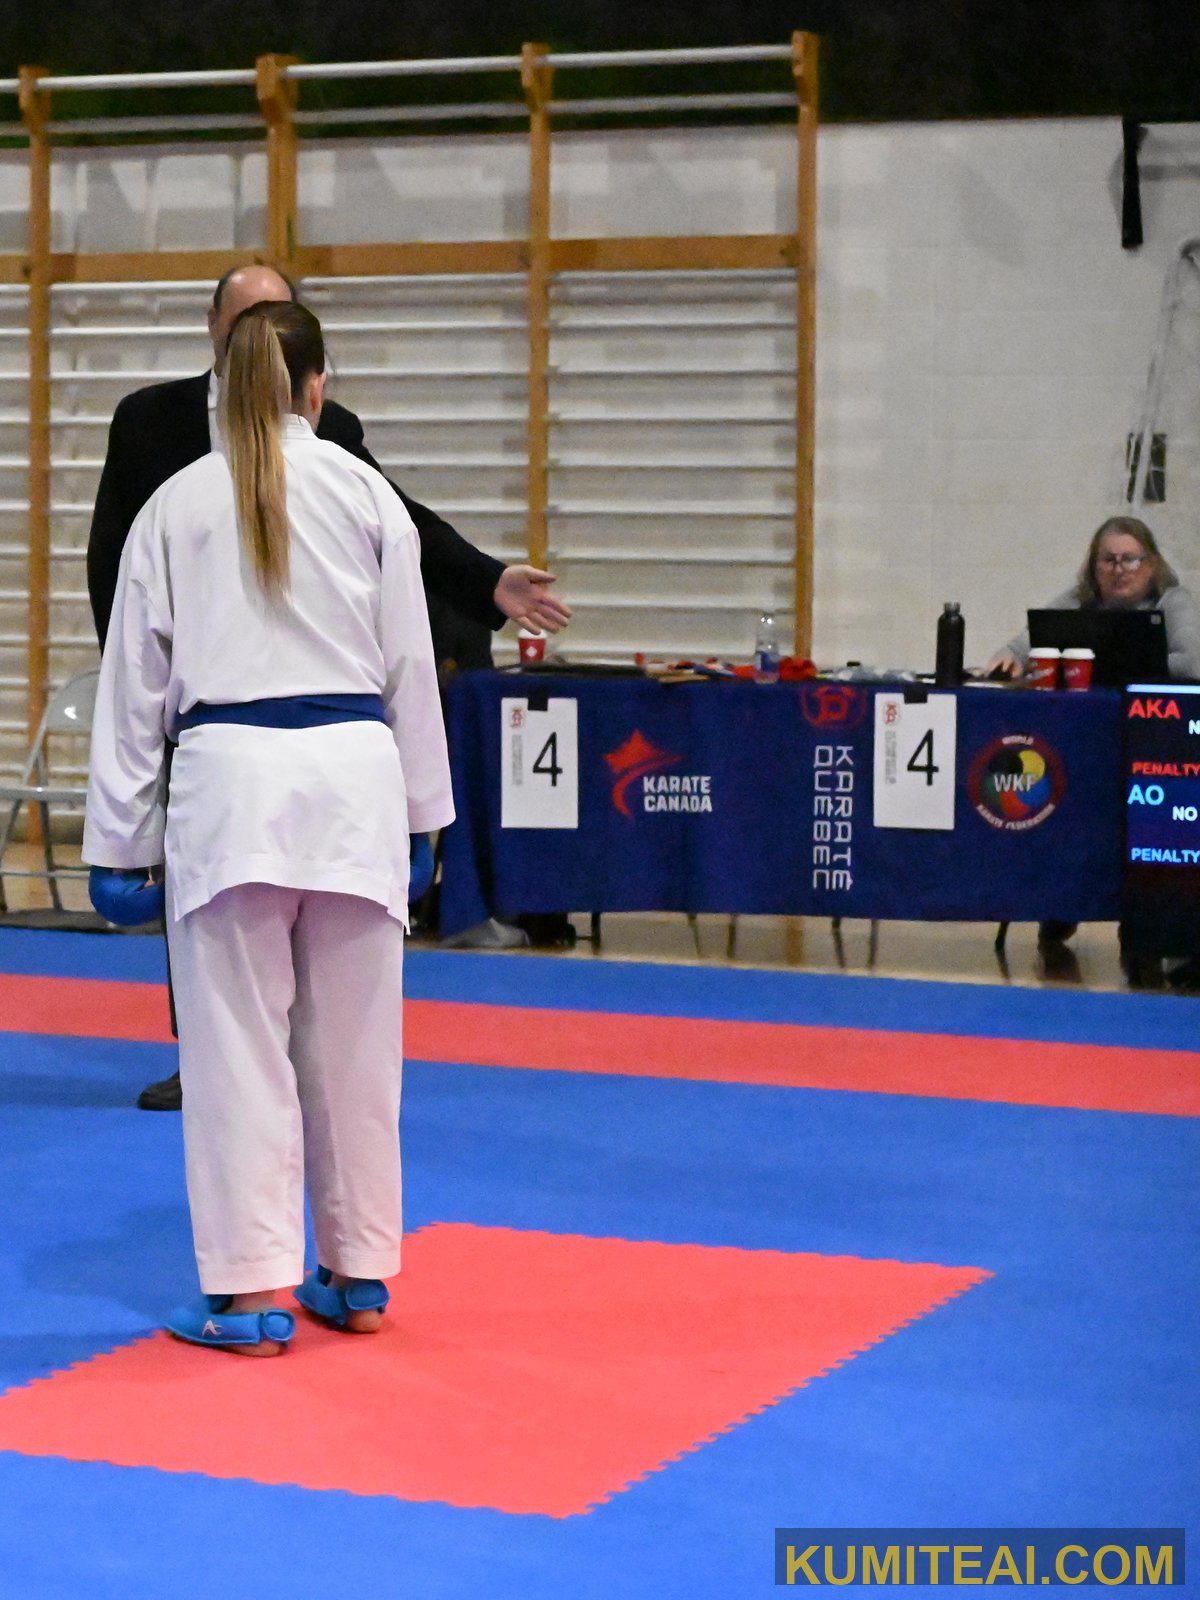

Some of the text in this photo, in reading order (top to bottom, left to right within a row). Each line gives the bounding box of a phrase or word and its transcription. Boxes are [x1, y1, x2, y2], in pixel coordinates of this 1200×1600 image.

[1128, 699, 1181, 720] AKA
[532, 731, 563, 787] 4
[907, 729, 939, 786] 4
[1131, 762, 1200, 776] PENALTY
[643, 776, 712, 794] KARATE
[994, 773, 1036, 793] WKF
[643, 795, 713, 813] CANADA
[1127, 784, 1165, 806] AO
[1172, 805, 1198, 821] NO
[1131, 848, 1200, 863] PENALTY
